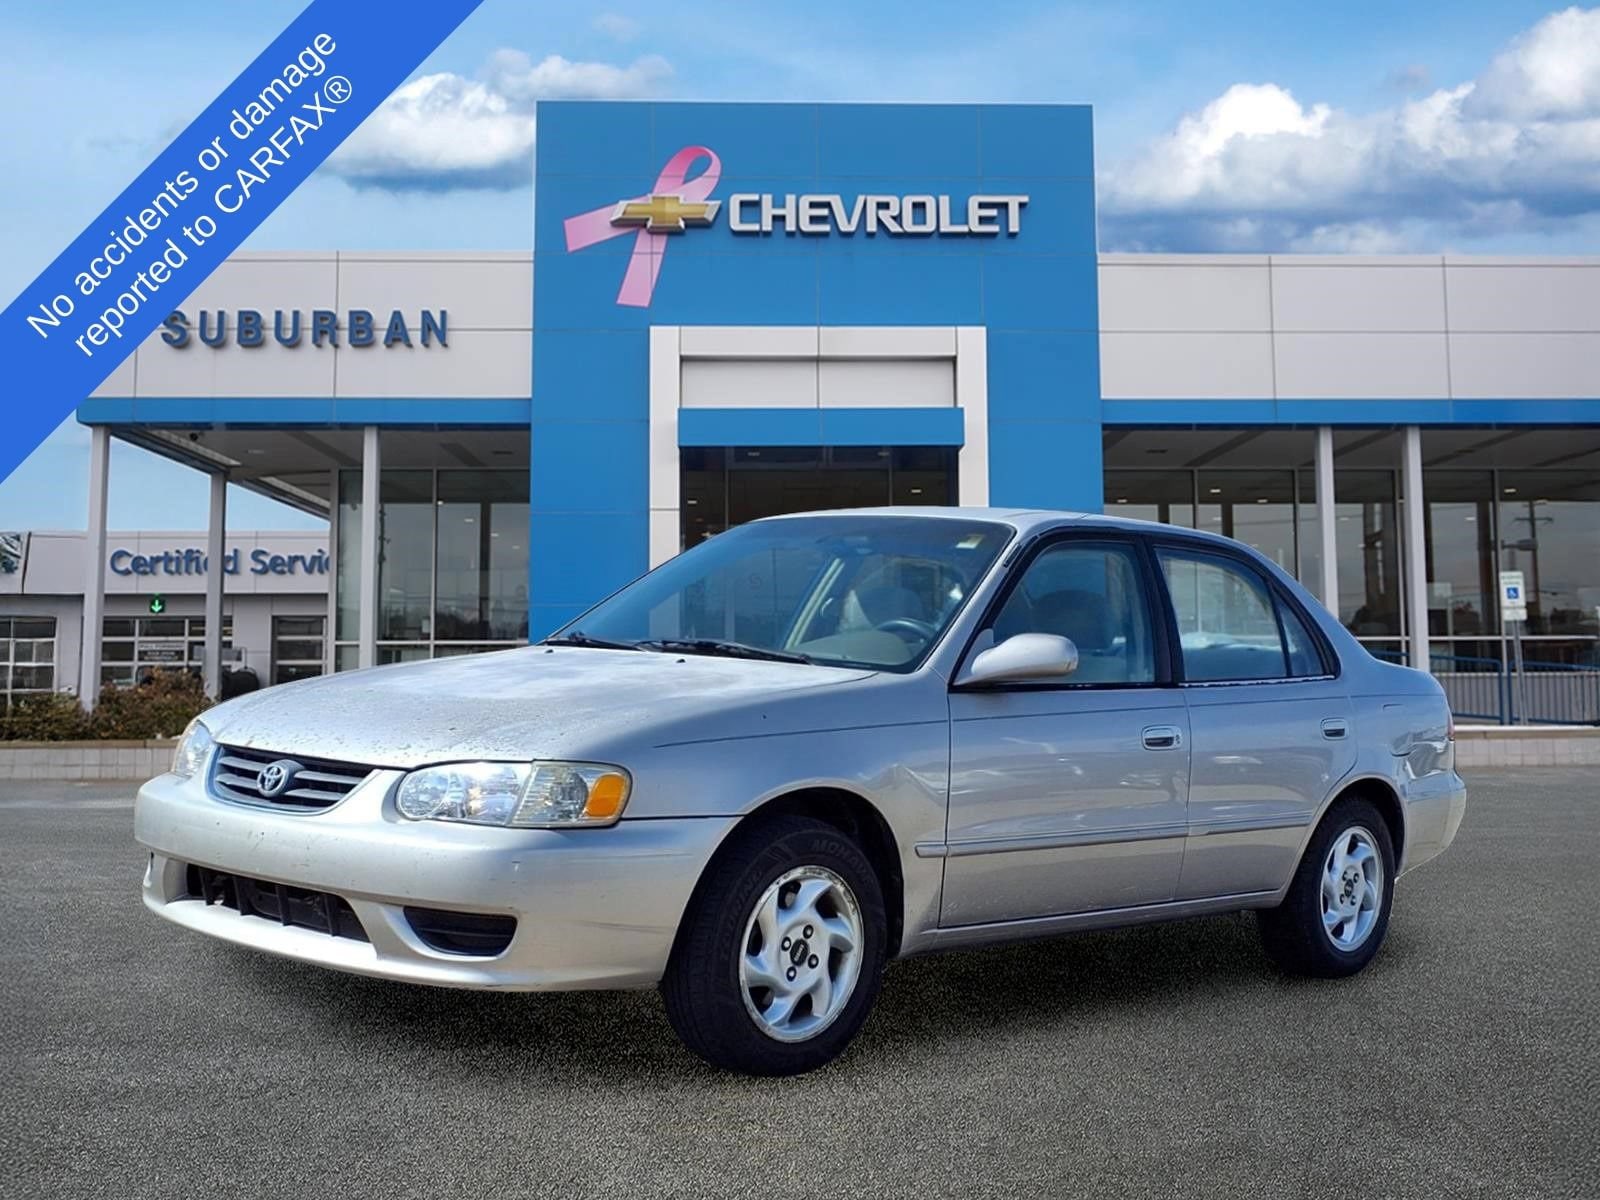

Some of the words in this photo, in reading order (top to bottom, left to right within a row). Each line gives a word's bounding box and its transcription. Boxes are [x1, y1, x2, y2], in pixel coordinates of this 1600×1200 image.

[728, 193, 1029, 235] CHEVROLET
[161, 309, 449, 348] SUBURBAN
[110, 548, 240, 576] Certifid
